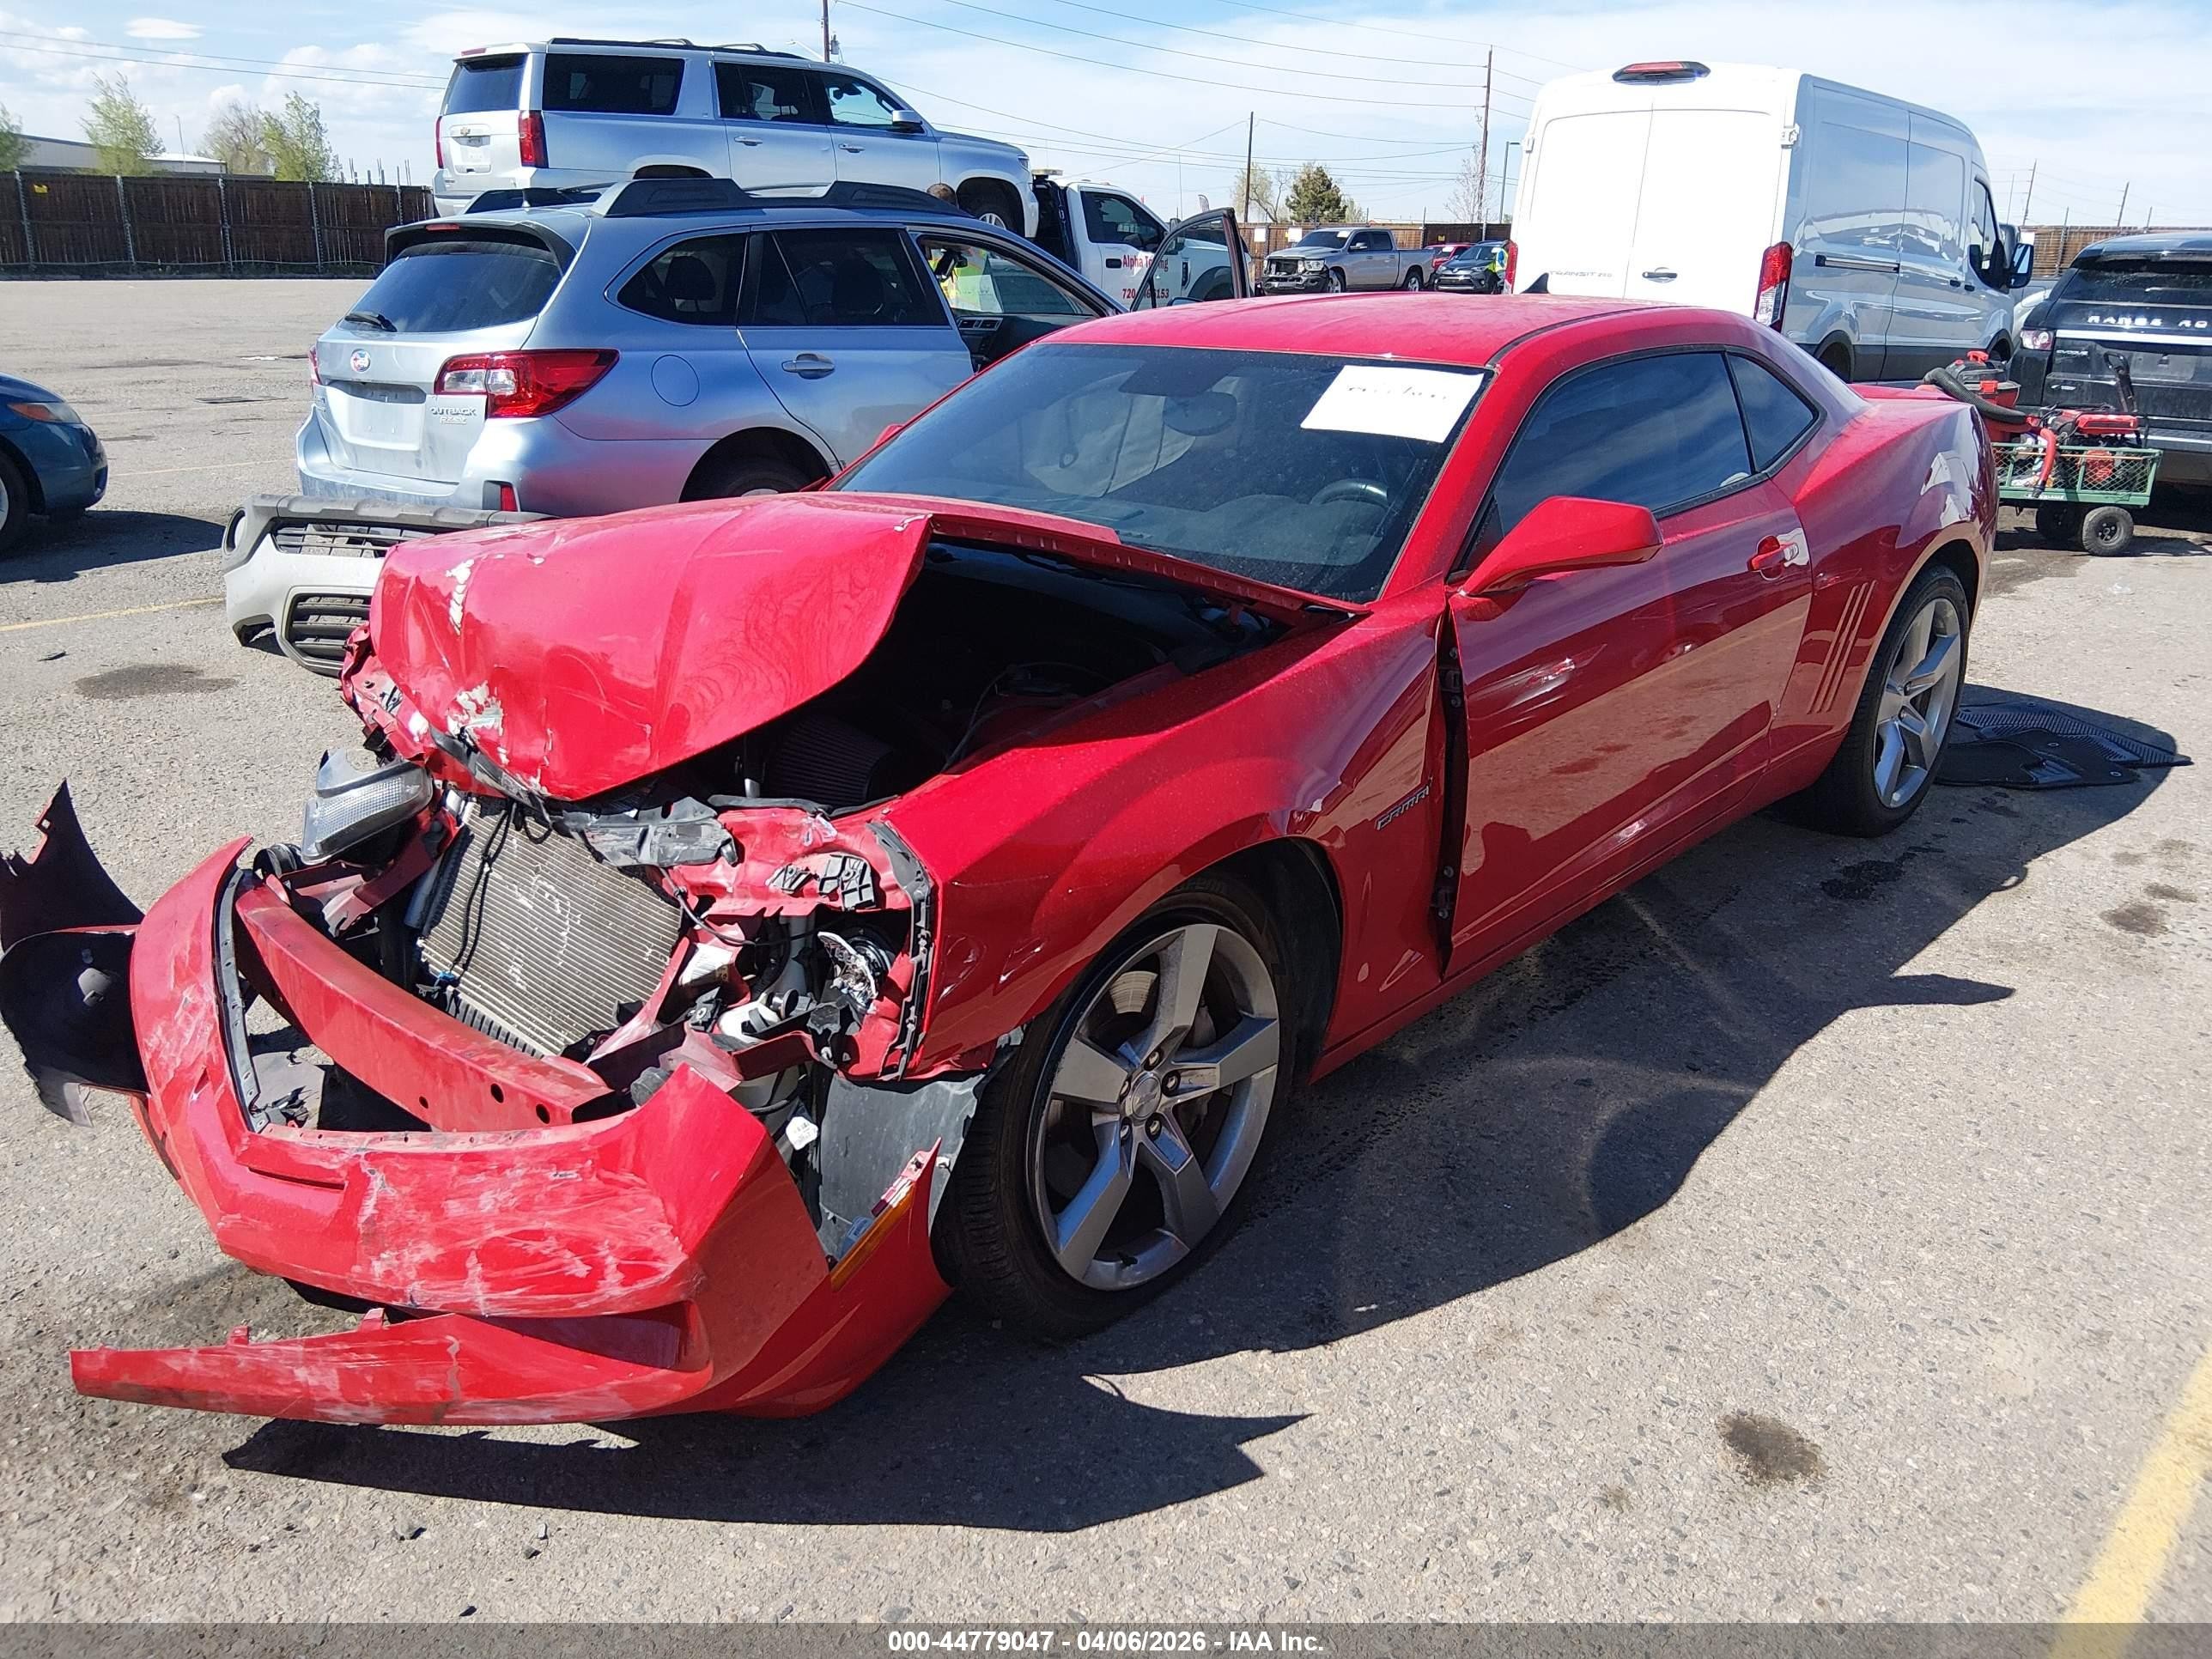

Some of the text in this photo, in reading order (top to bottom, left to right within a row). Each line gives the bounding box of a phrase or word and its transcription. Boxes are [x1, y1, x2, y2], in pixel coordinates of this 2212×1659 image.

[1122, 255, 1169, 272] Alpha Tong
[2087, 315, 2163, 326] RANGE
[429, 407, 477, 416] OUTBACK
